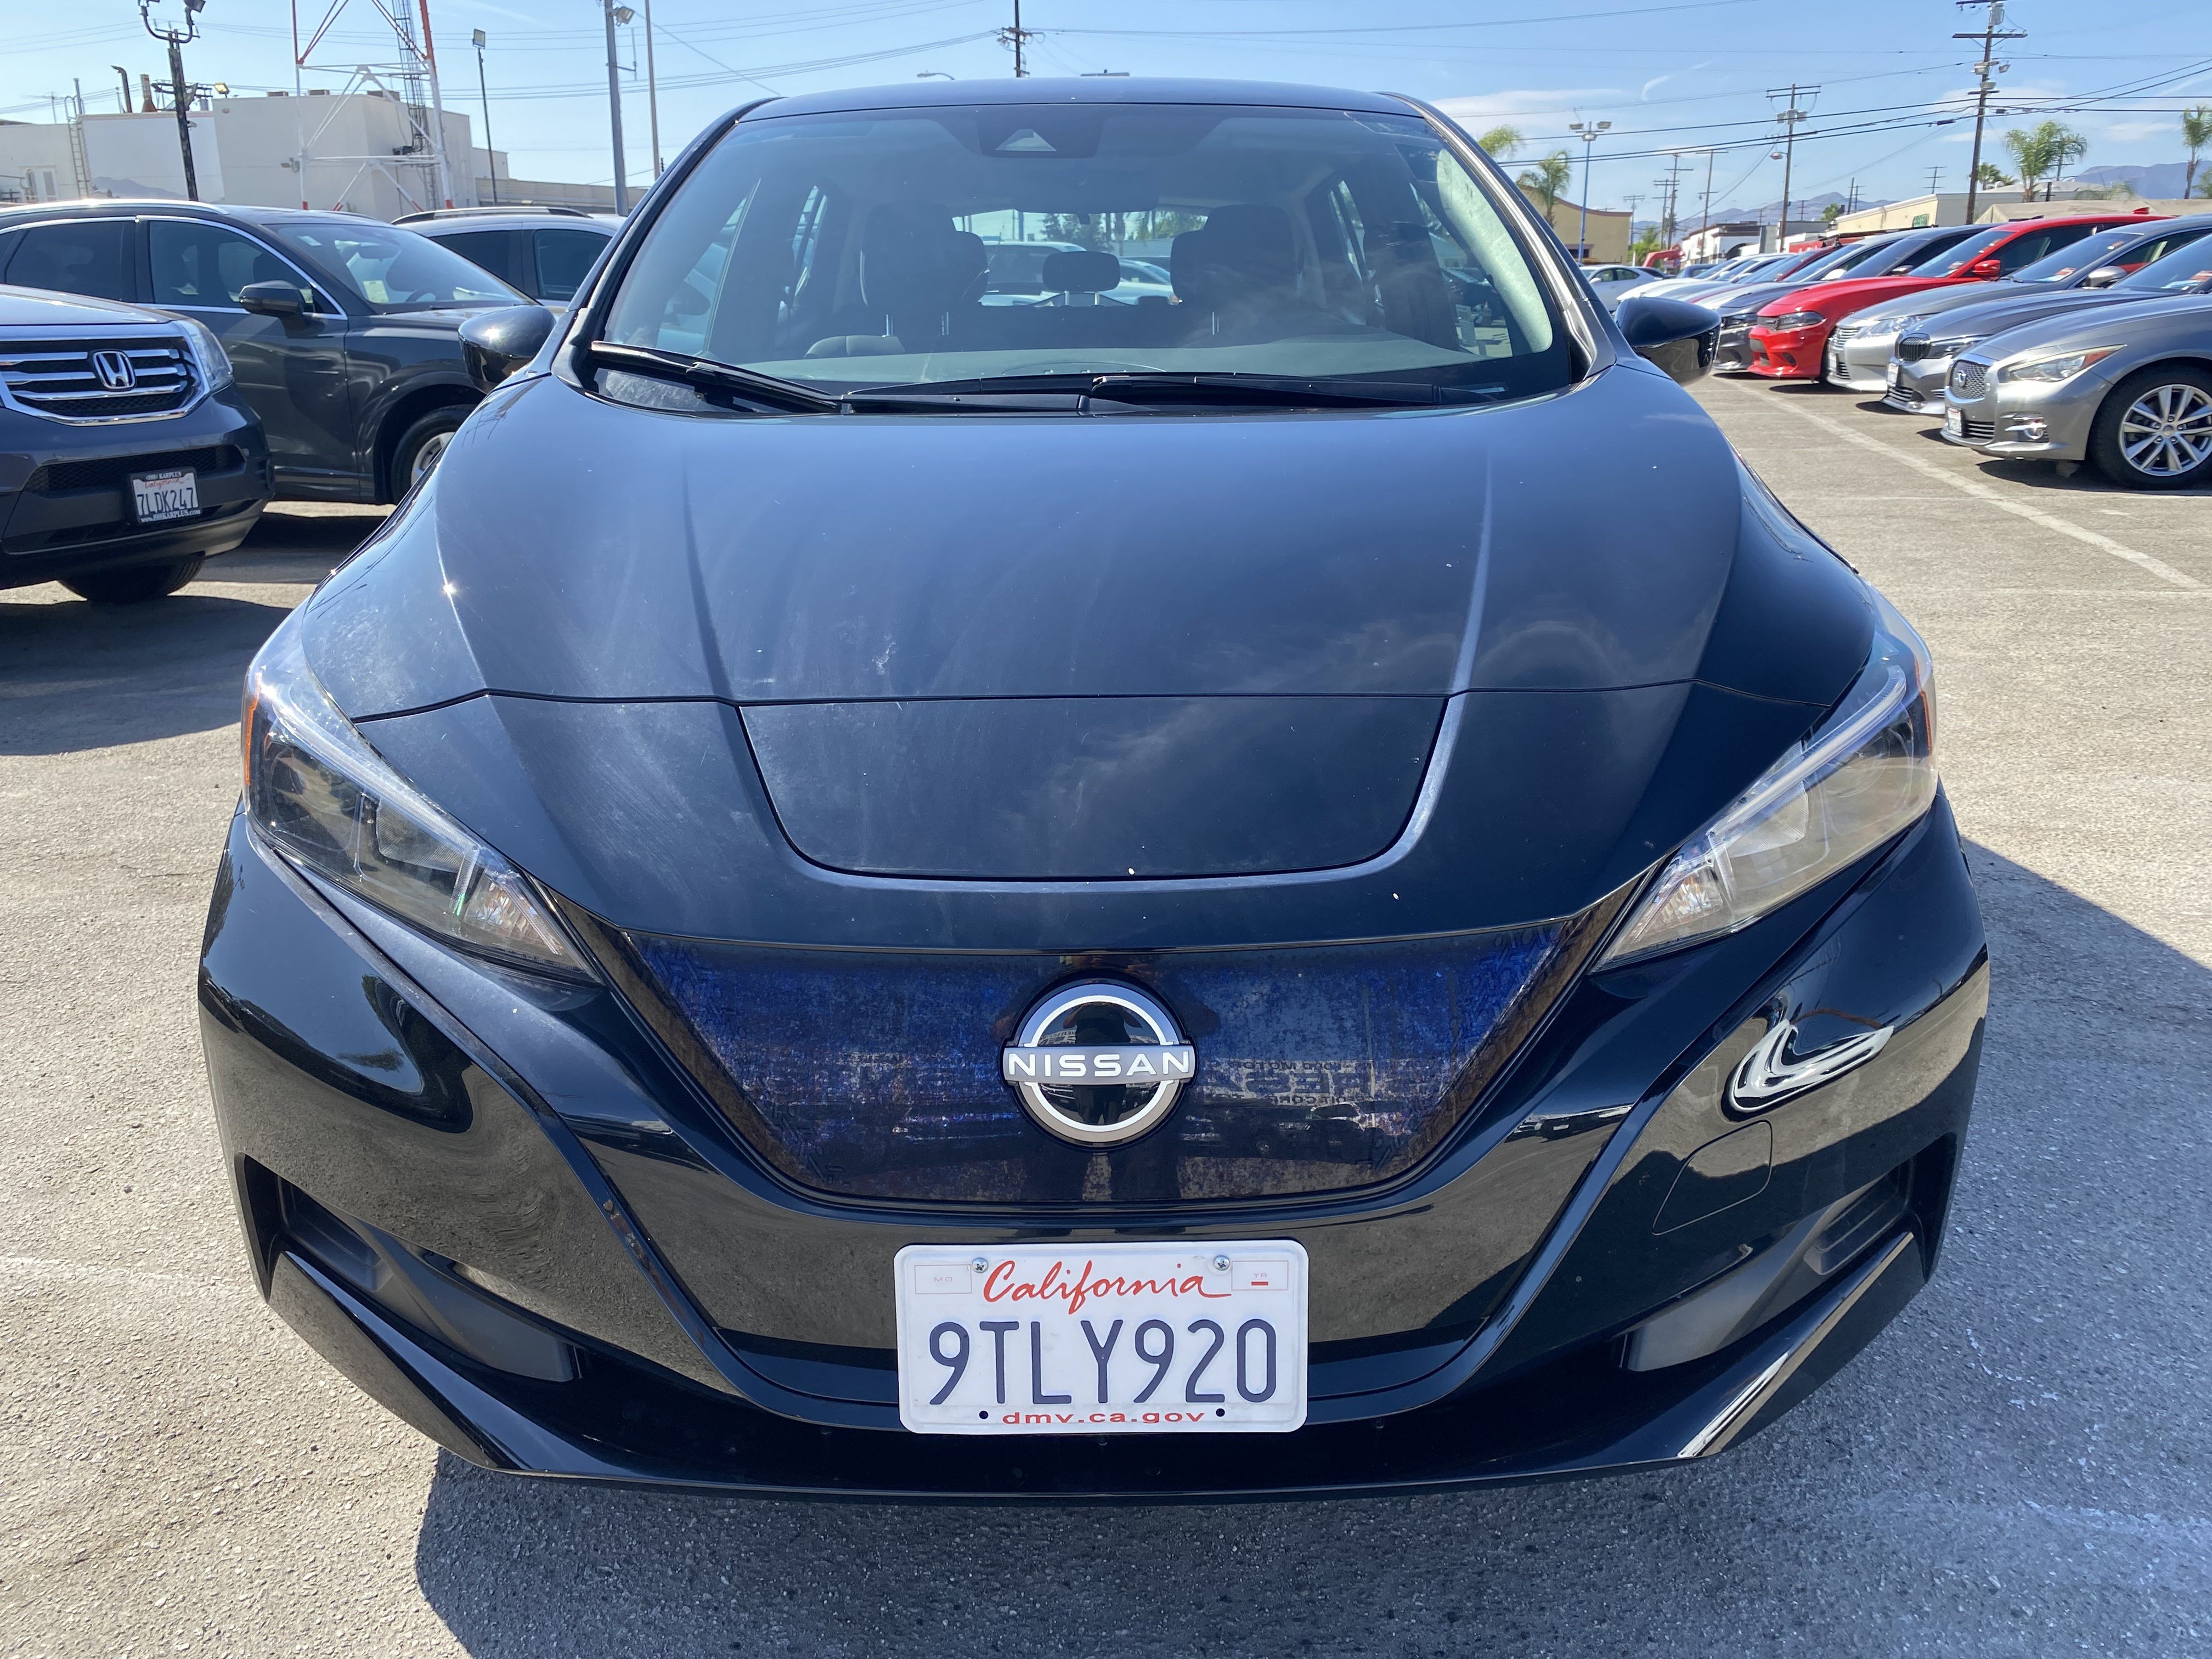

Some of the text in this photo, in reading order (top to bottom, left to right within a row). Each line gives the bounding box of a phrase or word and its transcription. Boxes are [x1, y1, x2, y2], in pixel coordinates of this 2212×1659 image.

[137, 487, 194, 516] 7LDK247
[1008, 1051, 1189, 1077] NISSAN
[983, 1260, 1232, 1315] California
[929, 1318, 1277, 1406] 9TLY920
[1002, 1411, 1205, 1425] dmv.ca.gov
